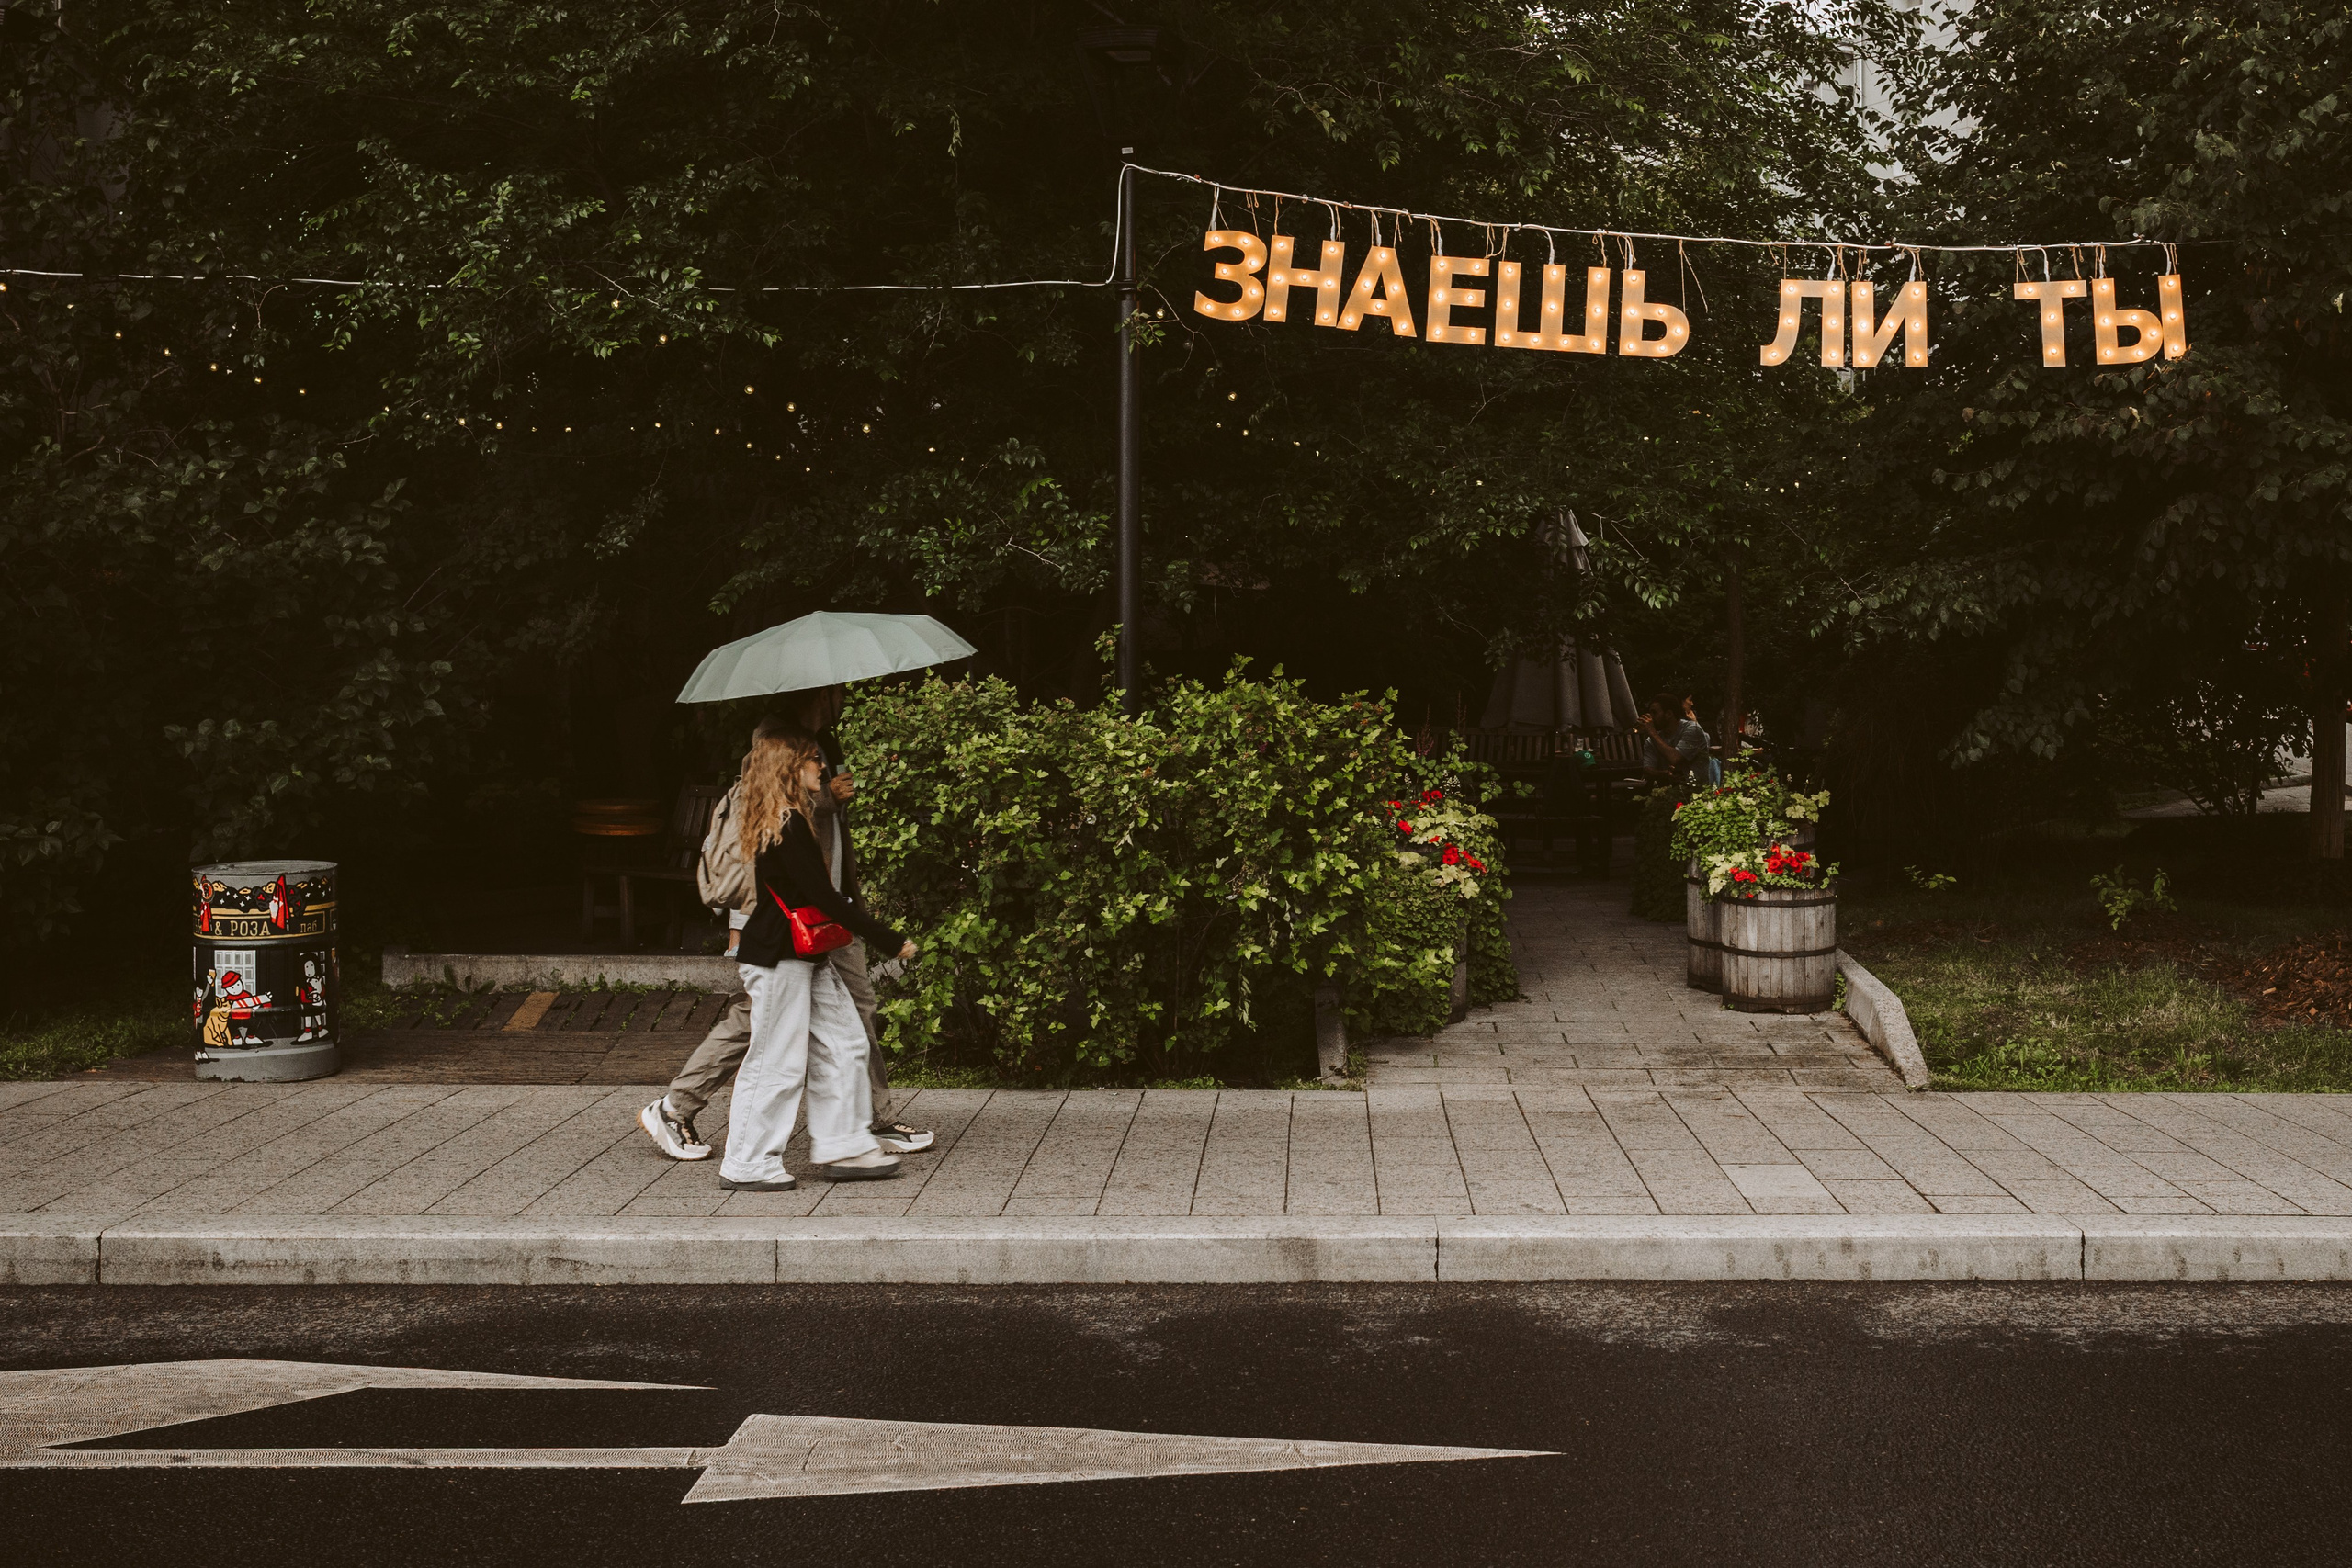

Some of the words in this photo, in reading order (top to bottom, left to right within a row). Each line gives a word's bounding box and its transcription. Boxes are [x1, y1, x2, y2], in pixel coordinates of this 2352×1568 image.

[1193, 229, 1691, 358] ЗНАЕШЬ
[1759, 279, 1928, 368] ЛИ
[2014, 274, 2188, 368] ТЫ
[214, 920, 223, 936] &
[230, 920, 271, 937] РОЗА
[300, 920, 317, 933] паб
